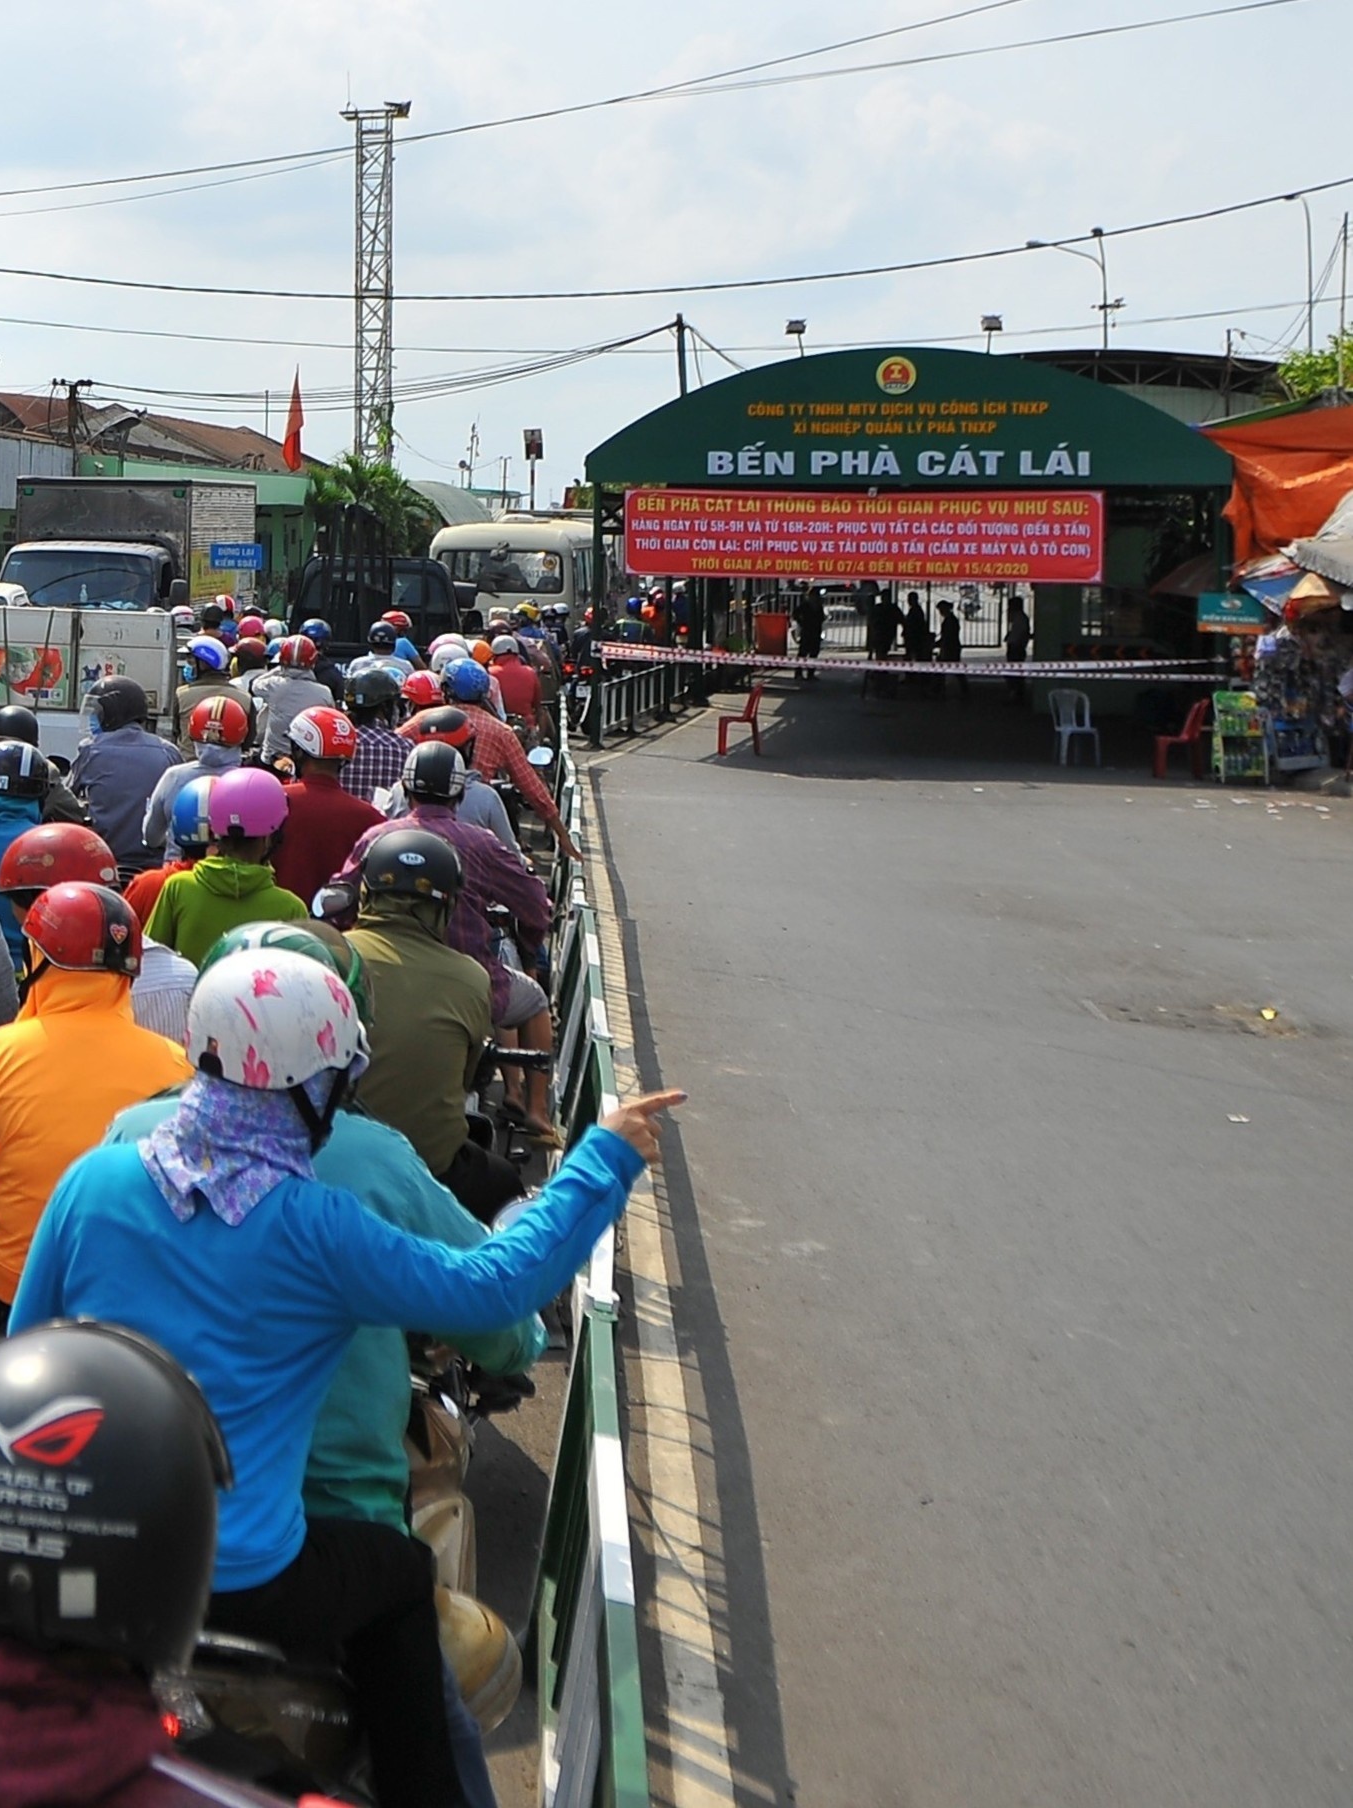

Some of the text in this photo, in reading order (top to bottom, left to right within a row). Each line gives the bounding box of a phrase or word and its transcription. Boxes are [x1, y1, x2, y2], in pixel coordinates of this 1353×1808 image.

[748, 400, 1049, 419] CÔNG TY TNHH MTV DỊCH VỤ CÔNG ÍCH TNXP
[811, 420, 861, 437] NGHIỆP
[908, 418, 923, 434] LÝ
[960, 421, 997, 433] TNXP
[707, 441, 1091, 476] BẾN PHÀ CÁT LÁI
[637, 493, 1089, 518] BẾN PHÀ CÁT LÁI THÔNG BÁO THỜI GIAN PHỤC VỤ NHƯ SAU:
[631, 517, 1091, 538] HÀNG NGÀY TỪ 5H-9H VÀ TỪ 16H-20H: PHỤC VỤ TẤT CẢ CÁC ĐỐI TƯỢNG (ĐẾN 8 TẤN)
[635, 536, 1091, 558] THỜI GIAN CÒN LẠI: CHỈ PHỤC VỤ XE TẢI DƯỚI 8 TẤN (CẤM XE MÁY VÀ Ô TÔ CON)
[691, 556, 1029, 575] THỜI GIAN ÁP DỤNG: TỪ 07/4 ĐẾN HẾT NGÀY 15/4/2020
